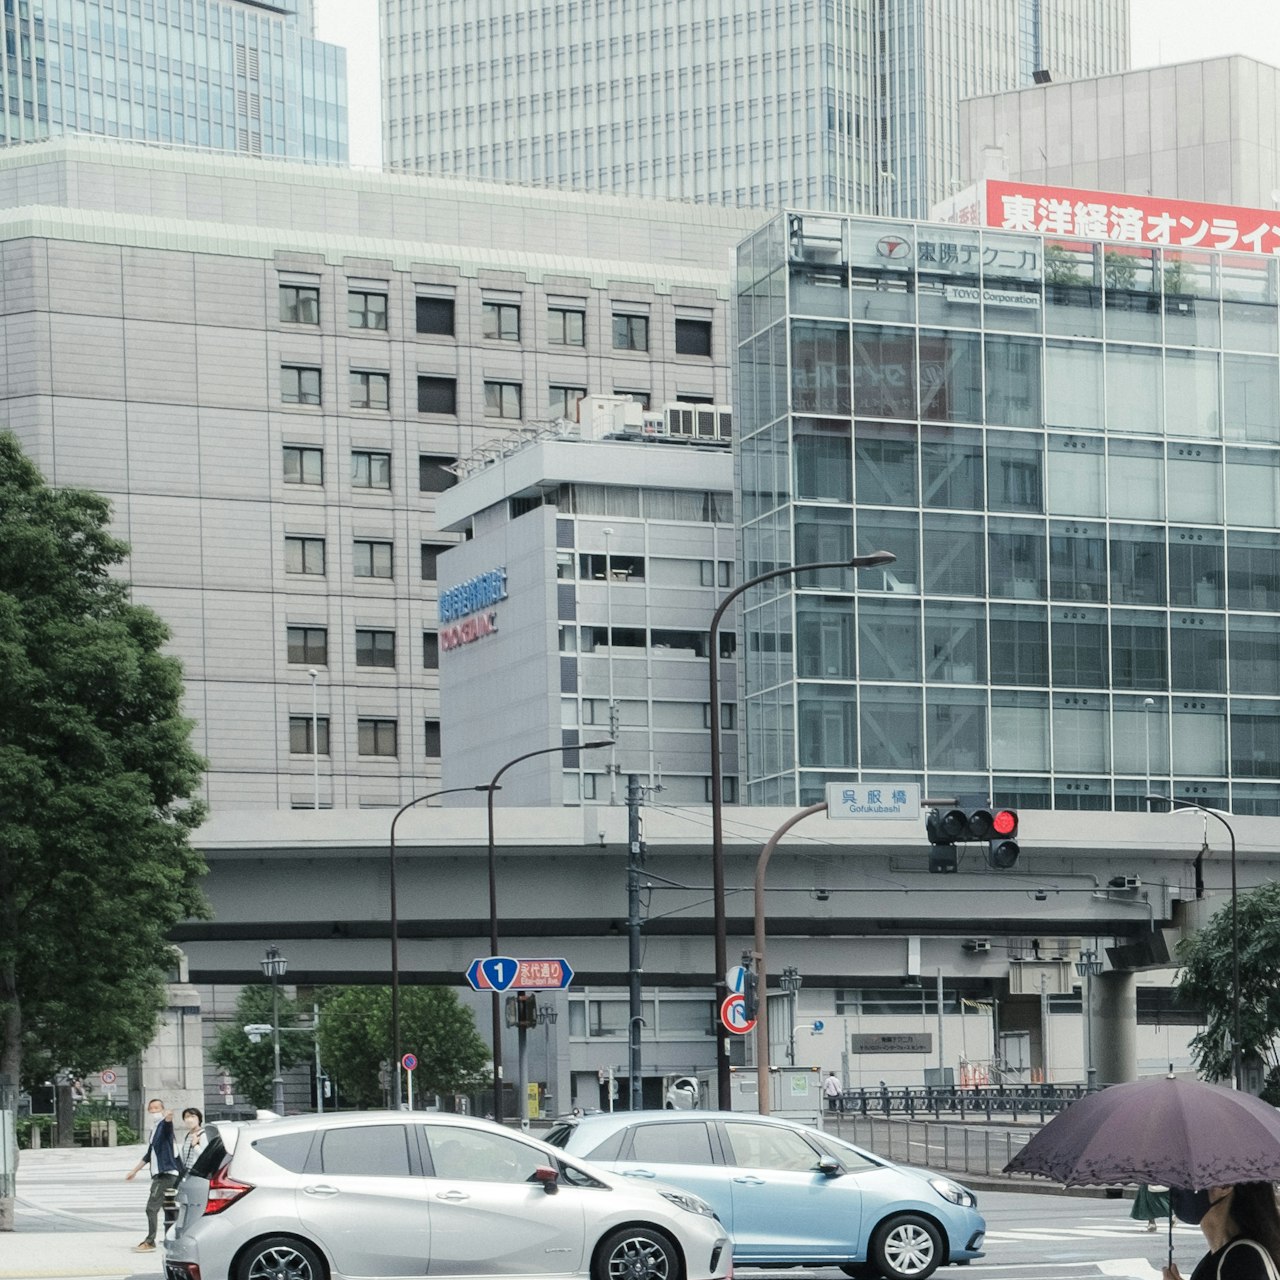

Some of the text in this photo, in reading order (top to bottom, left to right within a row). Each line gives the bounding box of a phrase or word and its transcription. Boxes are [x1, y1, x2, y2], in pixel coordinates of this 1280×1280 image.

[917, 241, 1037, 271] 東陽テクニカ
[952, 288, 1038, 306] TOYO Corporation
[842, 789, 907, 805] 呉服橋
[849, 804, 901, 813] Gofukubashi
[494, 962, 504, 983] 1
[521, 963, 560, 978] 永代通り
